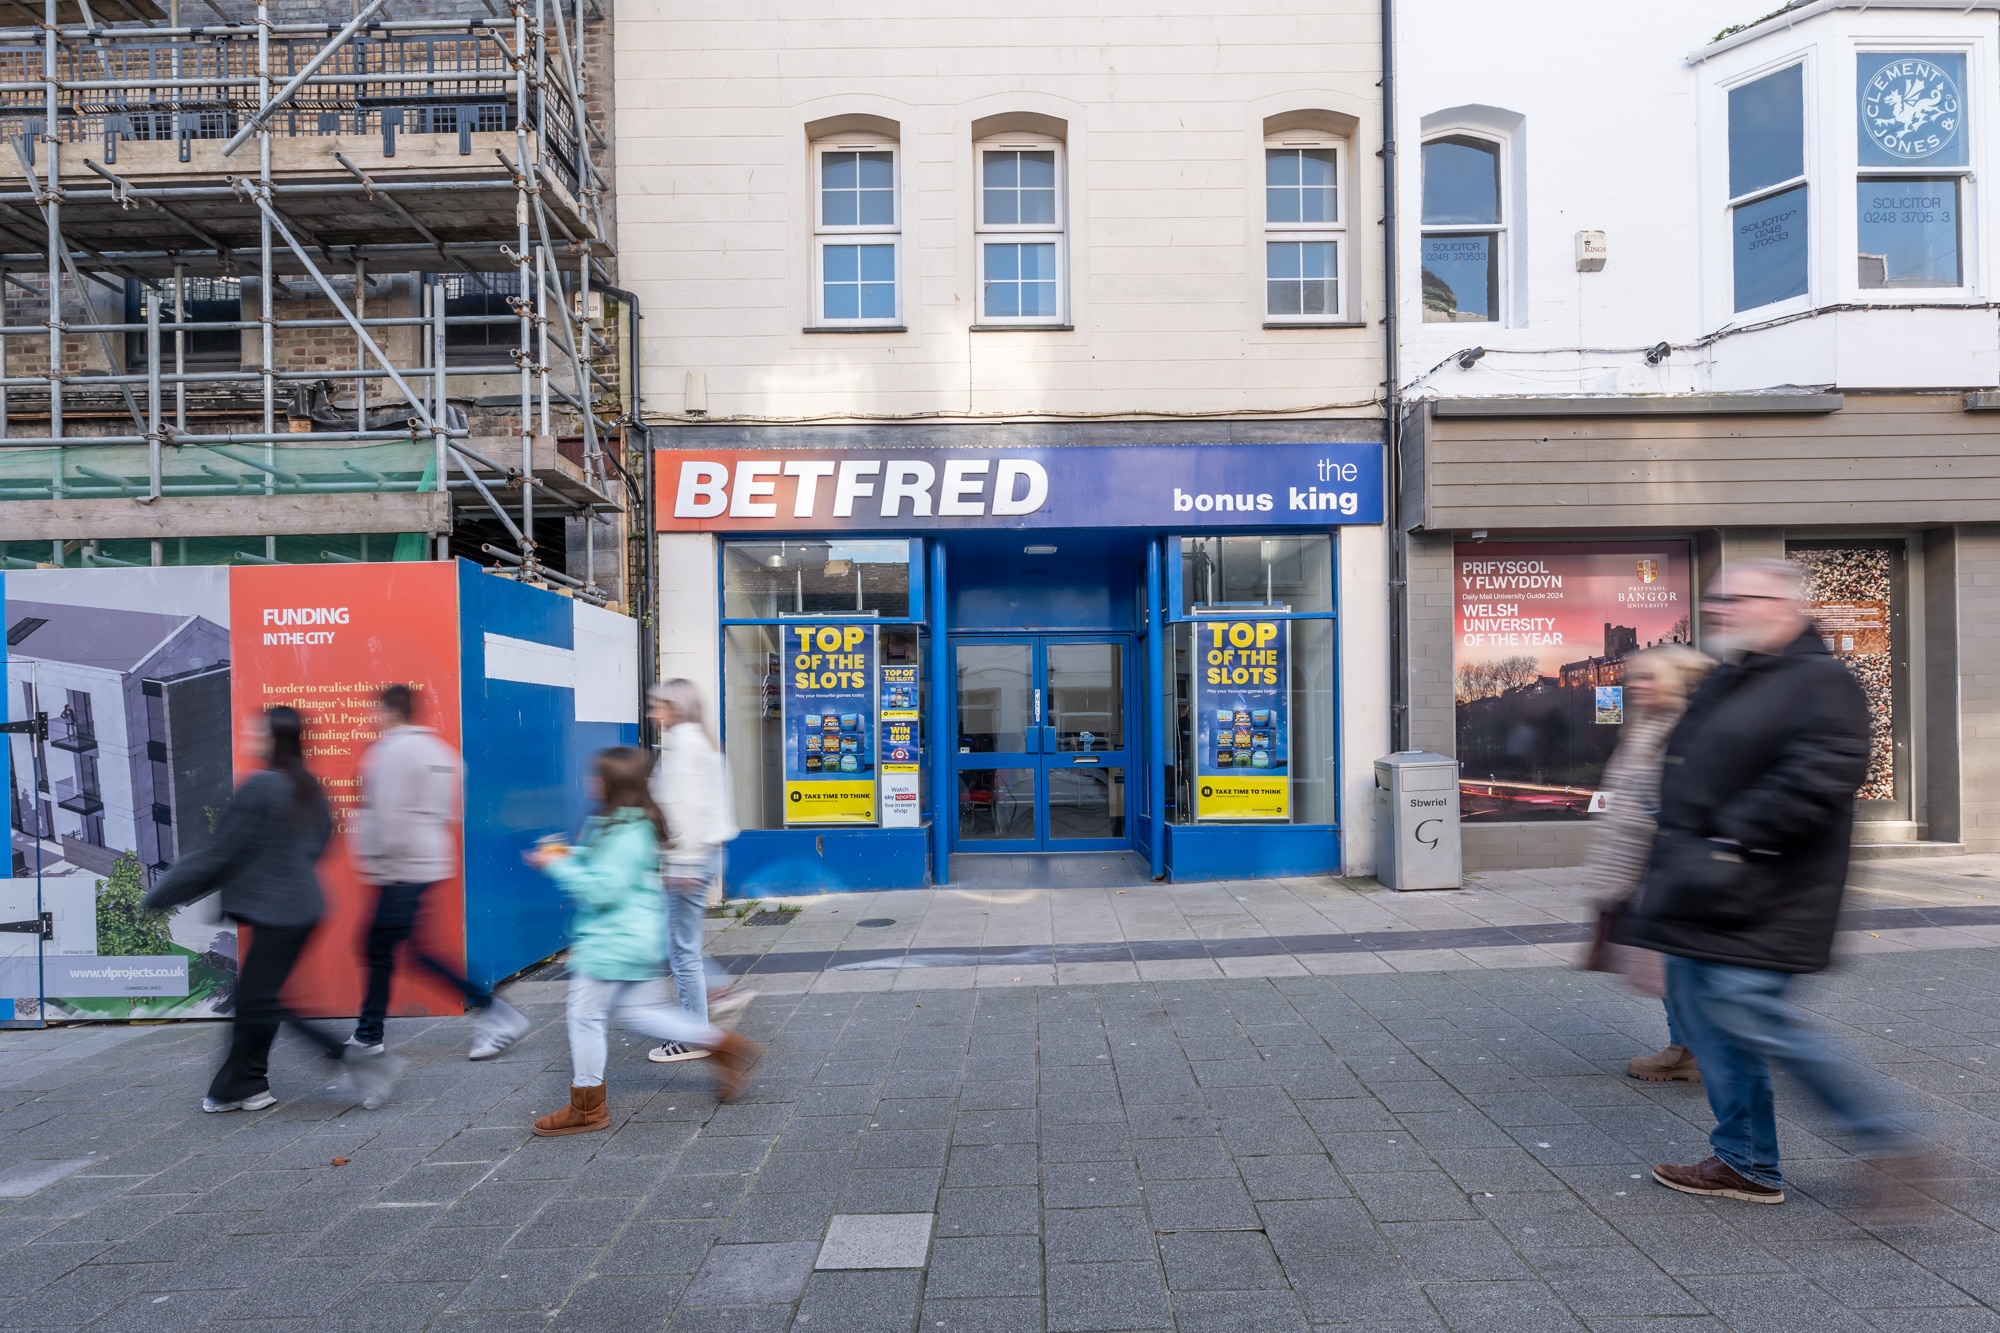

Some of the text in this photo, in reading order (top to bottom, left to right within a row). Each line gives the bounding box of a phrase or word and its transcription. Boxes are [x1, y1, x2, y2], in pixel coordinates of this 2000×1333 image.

[1866, 62, 1941, 117] CLEMENT
[1941, 117, 1955, 131] &
[1873, 128, 1940, 153] JONES
[1872, 197, 1941, 209] SOLICITOR
[1864, 211, 1897, 223] 0248
[1755, 224, 1782, 239] 0248
[1432, 242, 1480, 252] SOLICITOR
[1748, 231, 1789, 250] 370533
[1426, 252, 1486, 262] 0248 370533
[1317, 458, 1358, 482] the
[674, 459, 1049, 518] BETFRED
[1174, 486, 1358, 515] bonus king
[1462, 560, 1549, 575] PRIFYSGOL
[1462, 575, 1562, 590] Y FLWYDDYN
[1462, 593, 1478, 601] Daily
[1493, 592, 1526, 601] University
[1618, 592, 1678, 602] BANGOR
[263, 607, 350, 626] FUNDING
[1463, 603, 1518, 617] WELSH
[1463, 617, 1556, 632] UNIVERSITY
[278, 633, 304, 645] THE
[305, 631, 335, 645] CITY
[794, 627, 865, 652] TOP
[1207, 622, 1278, 648] TOP
[1464, 632, 1563, 647] OF THE YEAR
[795, 654, 865, 670] OF THE
[1207, 650, 1277, 665] OF THE
[795, 672, 865, 689] SLOTS
[1207, 667, 1277, 685] SLOTS
[262, 683, 274, 694] In
[275, 682, 305, 694] order
[306, 684, 317, 693] to
[318, 682, 353, 693] realise
[354, 681, 374, 692] this
[408, 680, 424, 691] for
[284, 699, 299, 709] of
[312, 715, 323, 725] at
[324, 714, 340, 724] VL
[308, 729, 350, 742] funding
[351, 729, 377, 740] from
[314, 746, 351, 756] bodies:
[322, 776, 364, 787] Council
[1410, 798, 1447, 808] Sbwriel
[69, 966, 185, 980] www.vlprojects.co.uk
